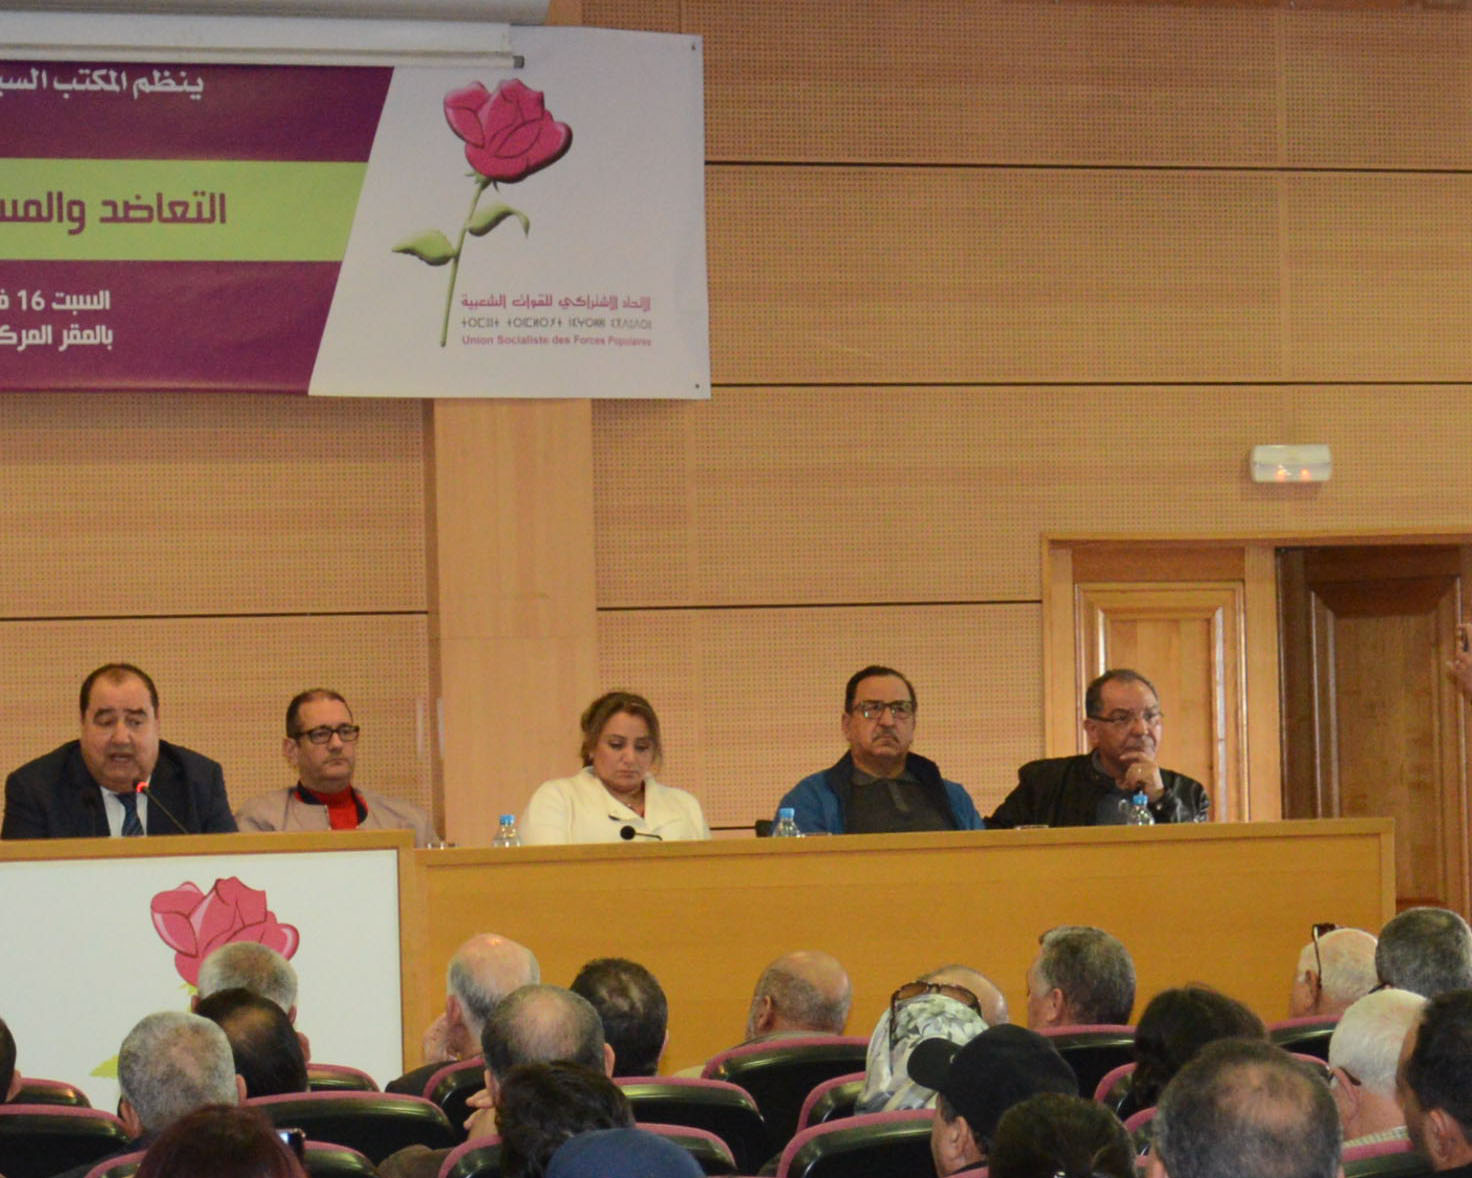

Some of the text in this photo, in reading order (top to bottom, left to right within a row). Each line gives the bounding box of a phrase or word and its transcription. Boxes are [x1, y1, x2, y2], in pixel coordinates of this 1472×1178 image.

[53, 68, 128, 99] المكتب
[132, 69, 205, 101] ينظم
[99, 190, 227, 225] التعاضد
[17, 289, 46, 311] 16
[51, 289, 111, 316] السبت
[461, 293, 506, 310] الشعبية
[58, 323, 114, 352] بالمقر
[462, 336, 494, 344] Union
[497, 335, 549, 344] Socialiste
[552, 335, 570, 344] des
[573, 335, 605, 344] Forces
